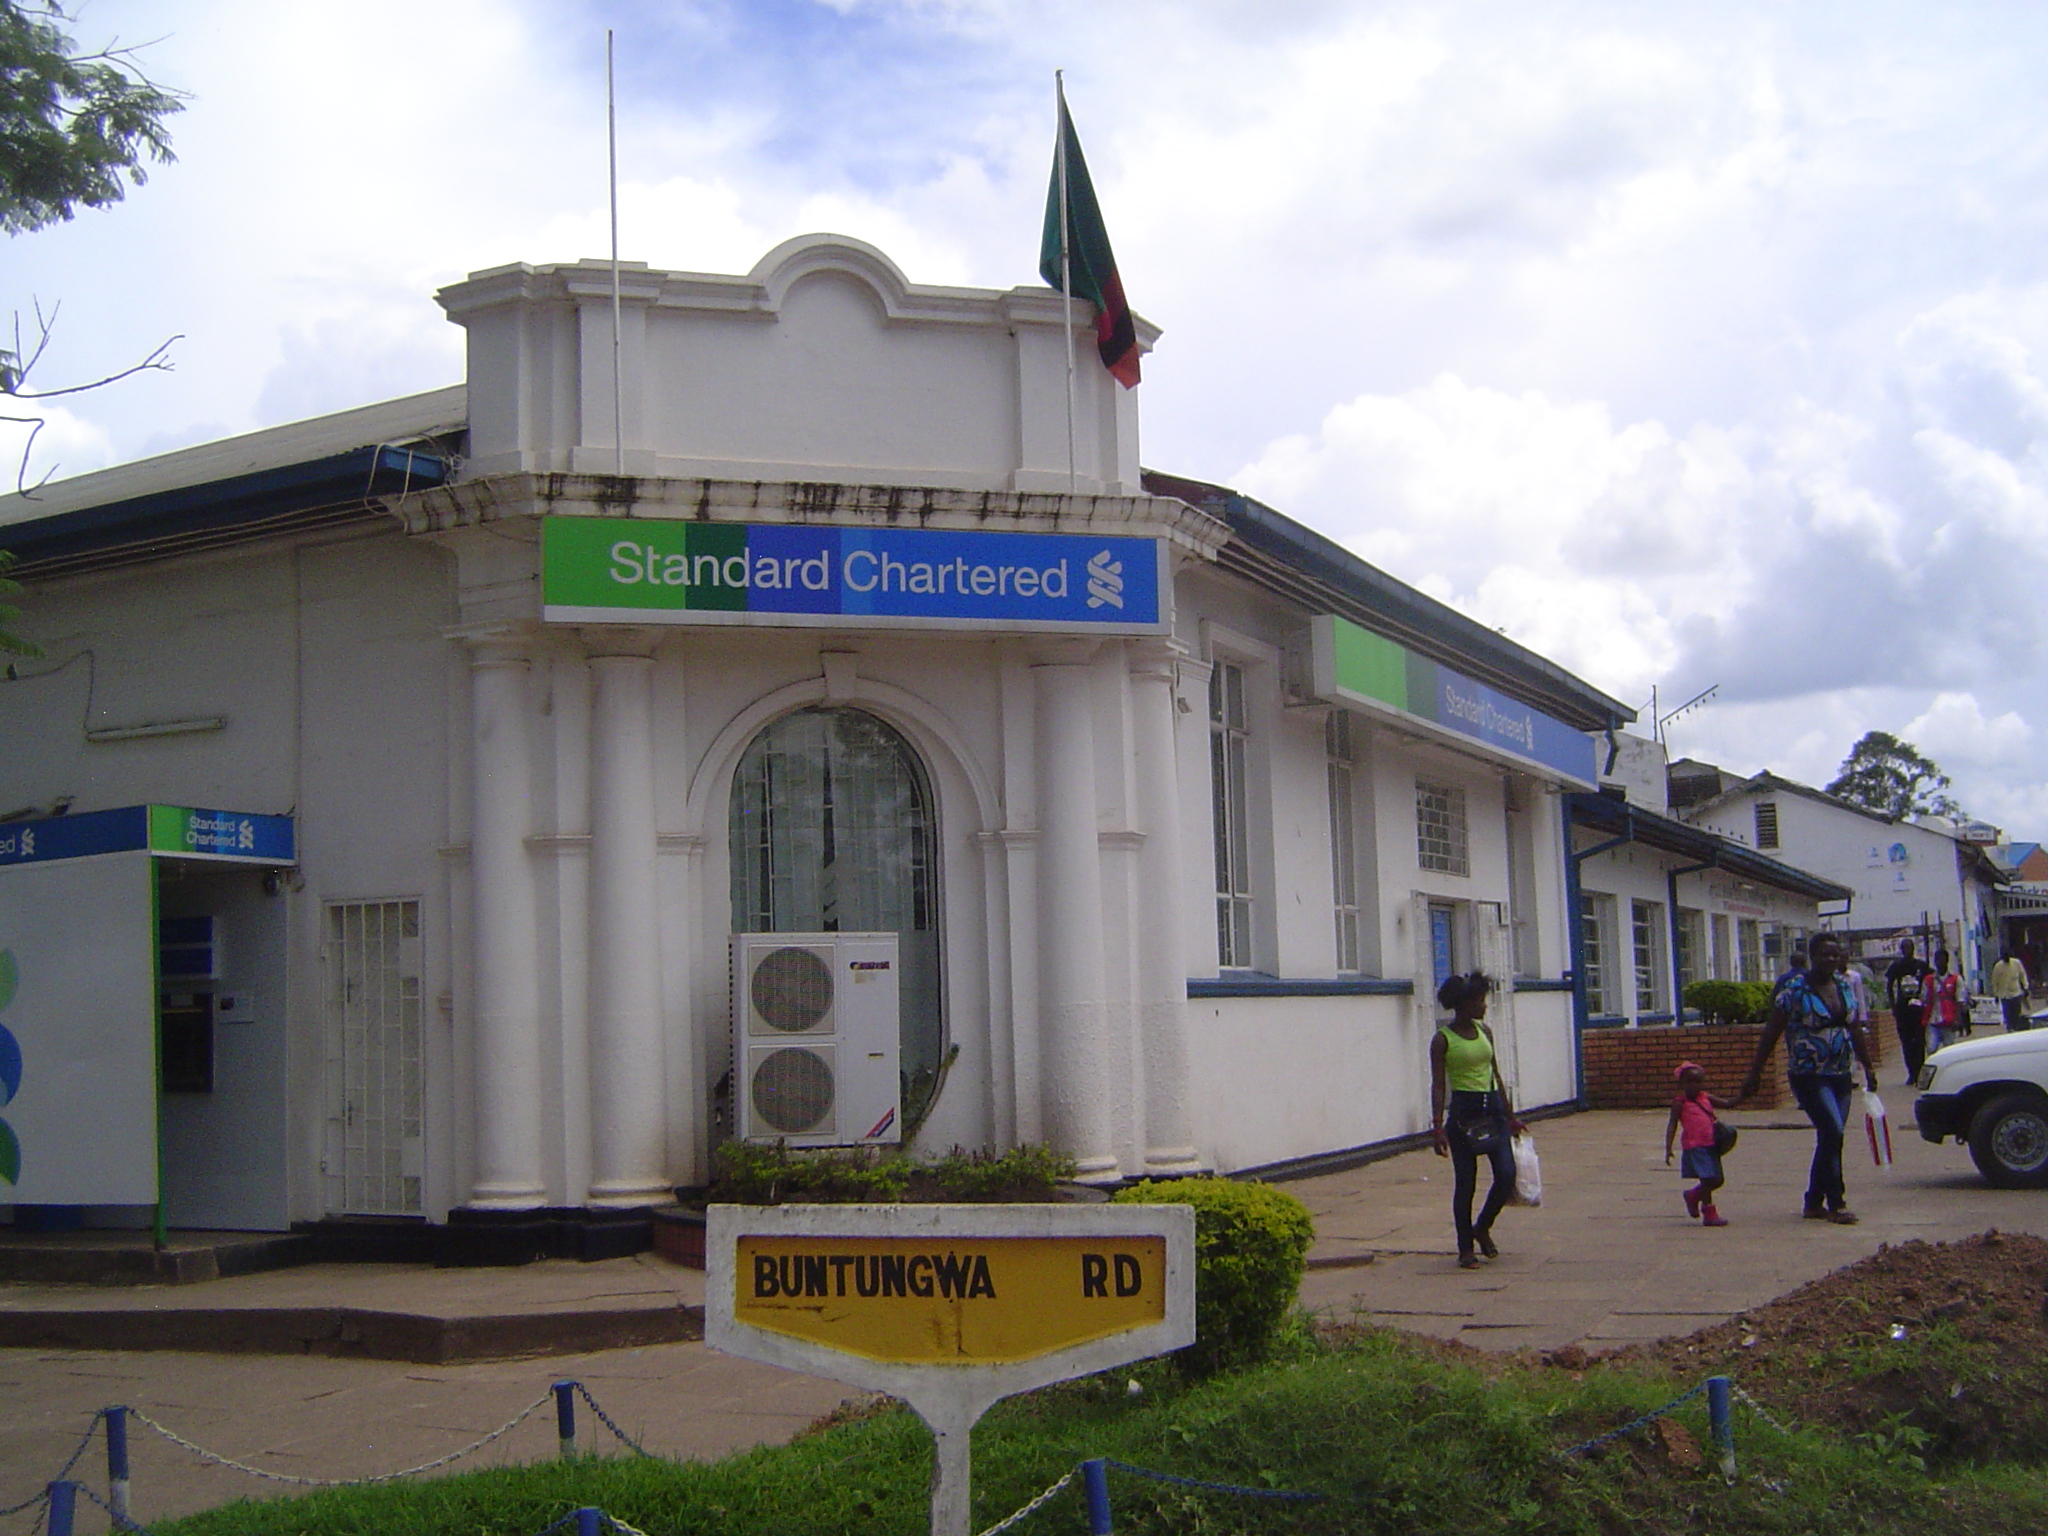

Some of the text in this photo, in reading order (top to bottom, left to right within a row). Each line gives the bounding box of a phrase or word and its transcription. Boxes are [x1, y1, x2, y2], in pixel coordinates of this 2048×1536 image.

[609, 541, 1067, 598] Standard Chartered
[1446, 684, 1525, 742] Standard Chartered
[186, 832, 236, 847] Chartered
[190, 815, 236, 832] Standard
[753, 1253, 1142, 1299] BUNTUNGWA RD
